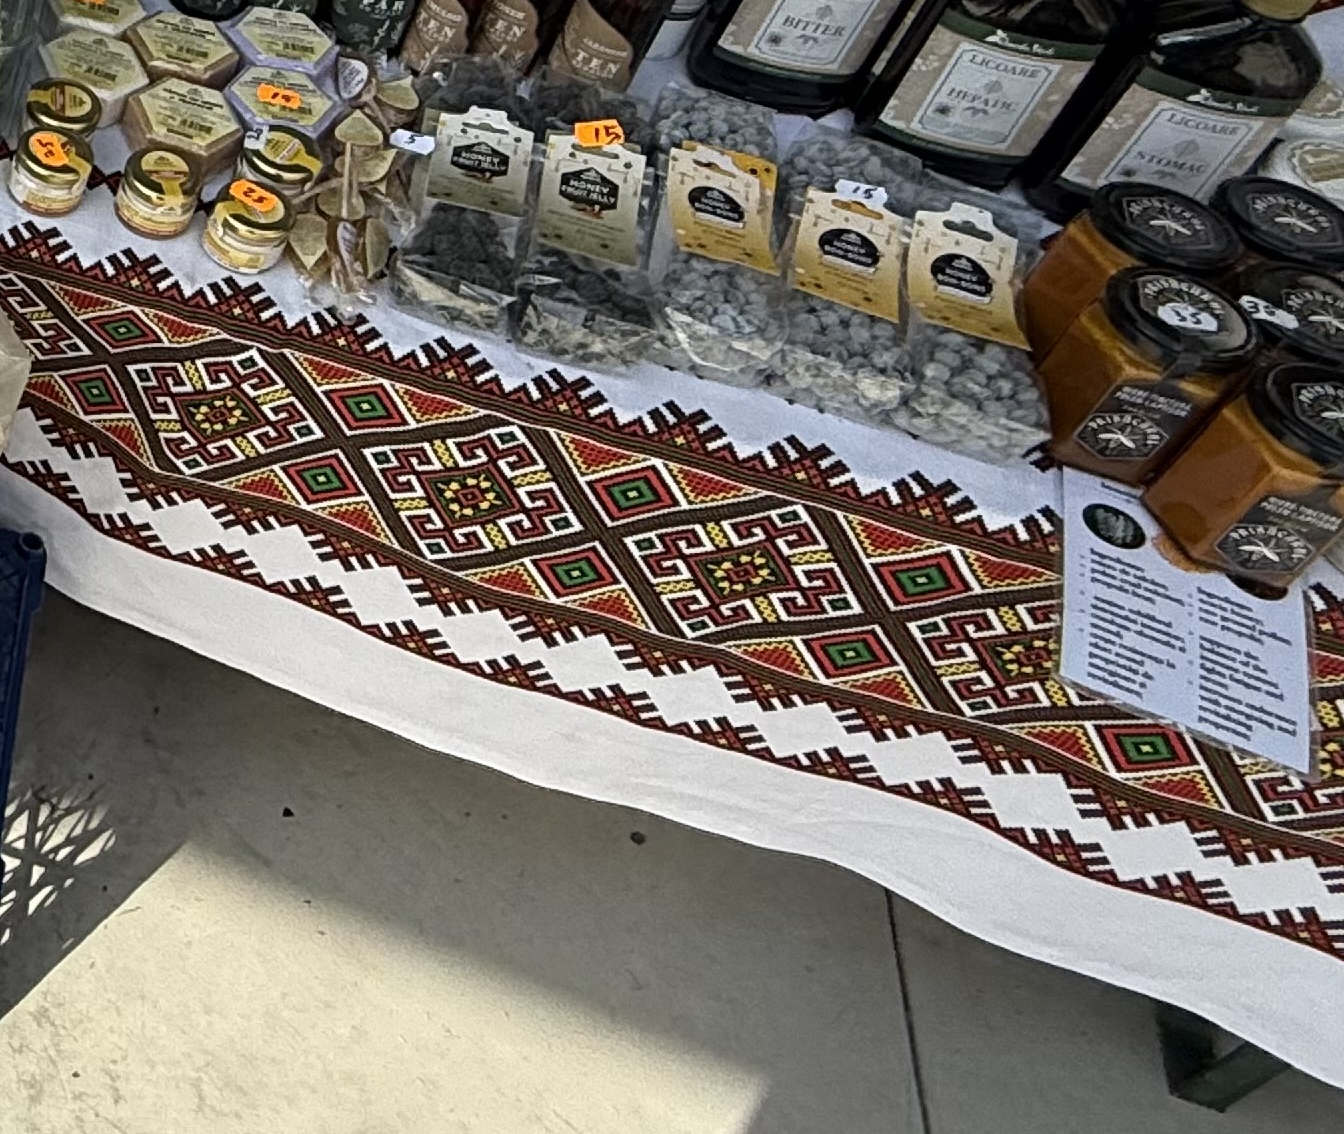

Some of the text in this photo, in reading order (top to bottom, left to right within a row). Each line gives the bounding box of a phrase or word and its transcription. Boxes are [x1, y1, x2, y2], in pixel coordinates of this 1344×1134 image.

[783, 15, 846, 37] BITTER
[969, 54, 1042, 78] LICOARE
[593, 124, 622, 145] 15
[1167, 113, 1242, 136] LICOARE
